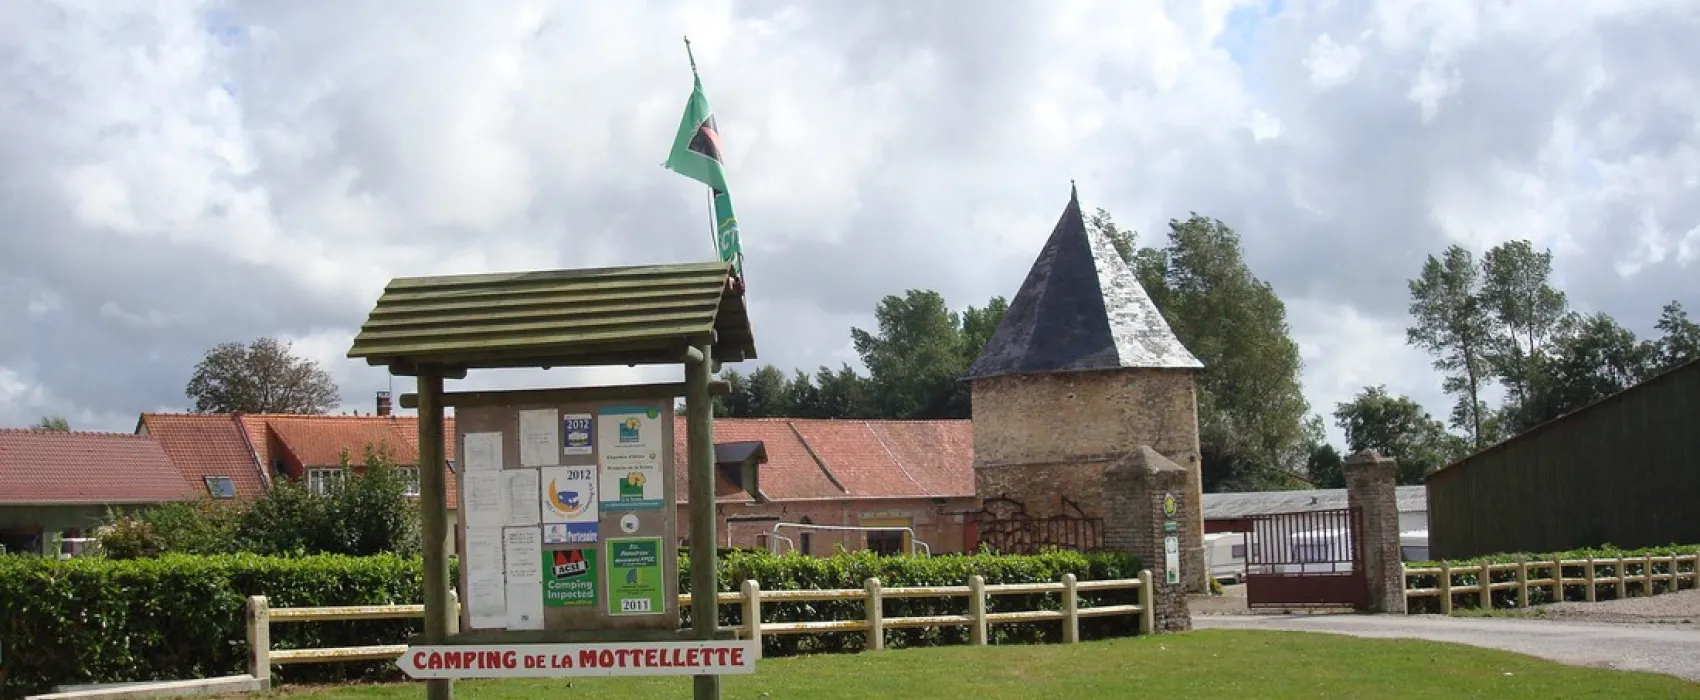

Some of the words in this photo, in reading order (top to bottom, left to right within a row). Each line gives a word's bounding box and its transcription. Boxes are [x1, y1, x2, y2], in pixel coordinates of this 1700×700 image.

[567, 419, 590, 430] 2012
[567, 469, 591, 480] 2012
[558, 563, 579, 573] ACSI
[548, 580, 593, 590] Camping
[547, 589, 594, 600] Inspected
[623, 600, 649, 610] 2011
[413, 651, 517, 670] CAMPING
[523, 655, 546, 669] DE
[551, 654, 573, 669] LA
[578, 647, 744, 668] MOTTELLETTE
